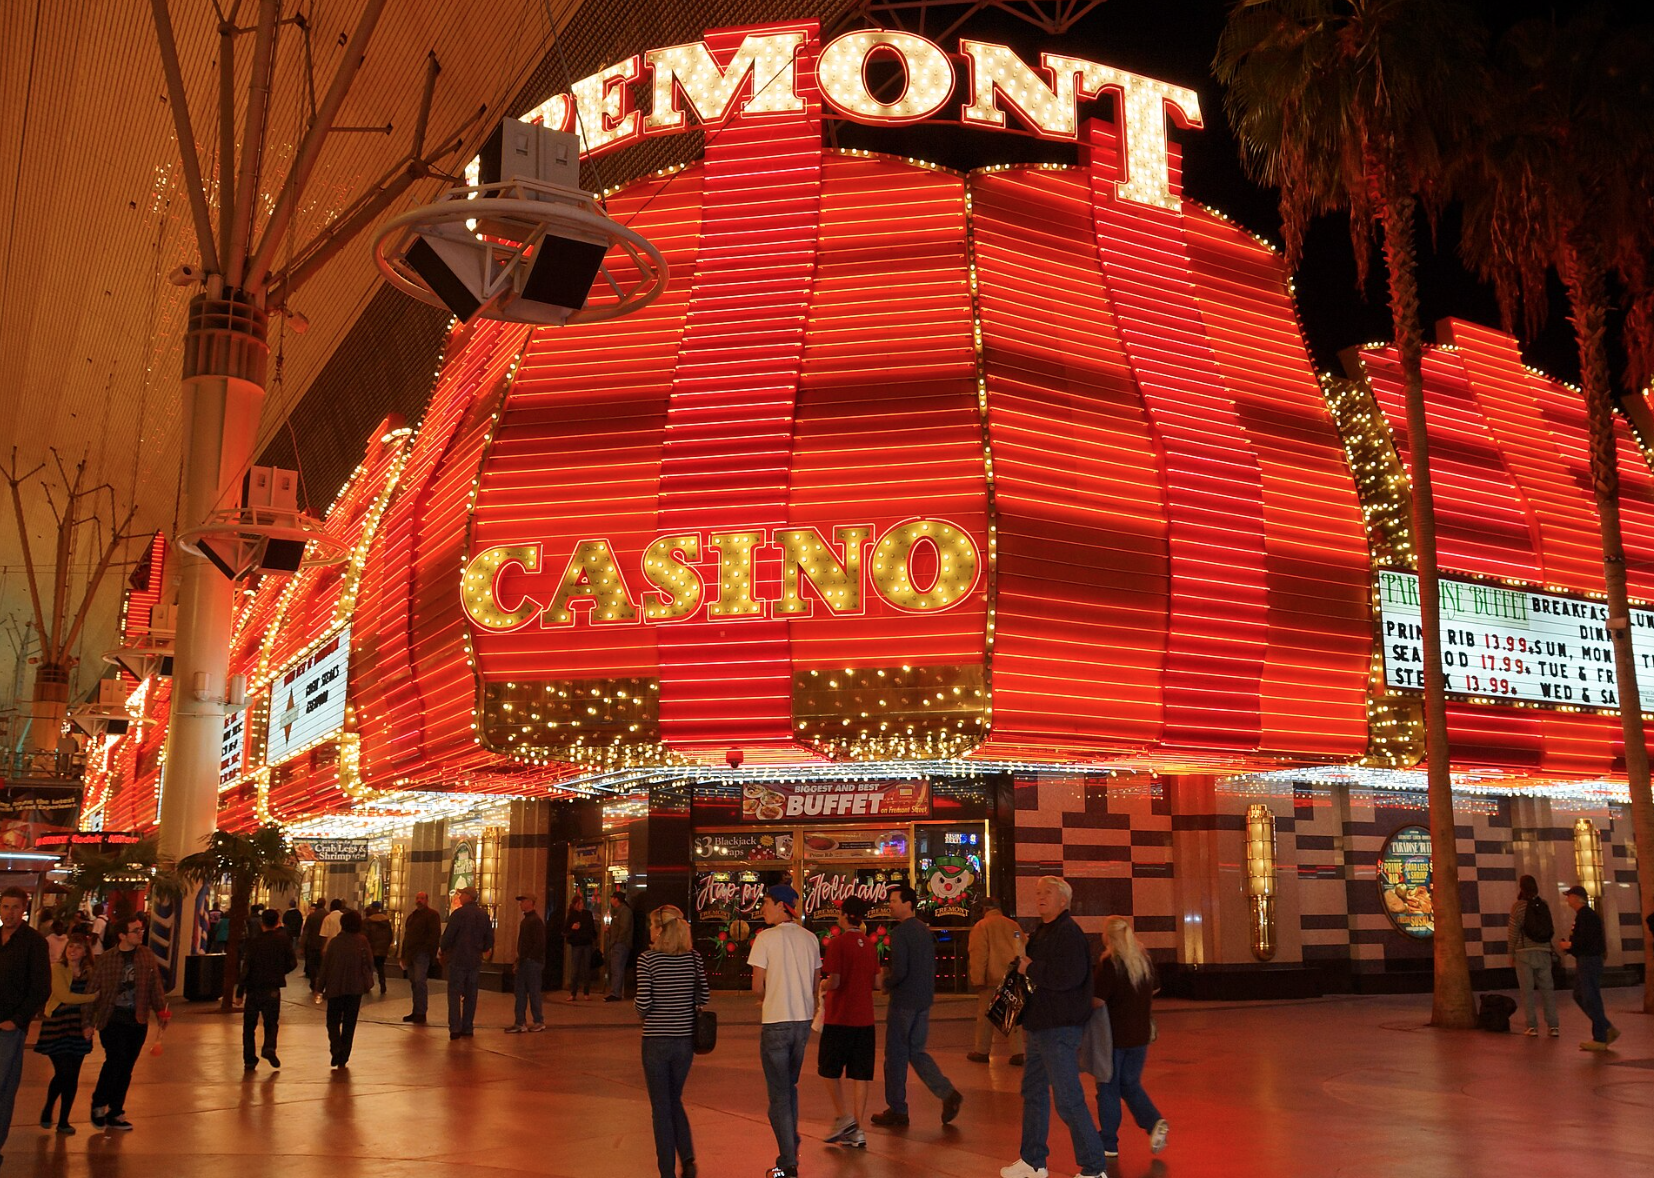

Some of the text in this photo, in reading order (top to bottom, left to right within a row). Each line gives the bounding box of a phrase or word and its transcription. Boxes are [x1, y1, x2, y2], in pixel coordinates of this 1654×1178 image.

[466, 28, 1206, 215] EMONT
[460, 517, 982, 633] CASINO
[1381, 573, 1528, 621] PARISE BUFFET
[1532, 597, 1607, 621] BREAKFAS
[1448, 629, 1475, 647] RIB
[1582, 646, 1612, 663] MON
[1393, 644, 1469, 668] SEAOD
[1538, 661, 1568, 679] TUE
[1579, 666, 1587, 681] &
[1597, 668, 1615, 684] FR
[1395, 667, 1452, 690] STEK
[1540, 682, 1573, 700] WED
[1582, 688, 1590, 703] &
[1601, 689, 1617, 704] SA
[795, 783, 880, 793] BIGGEST AND BEST
[786, 793, 884, 816] BUFFET
[889, 805, 910, 814] Fremont
[912, 805, 927, 814] Street
[315, 844, 366, 854] Crab Legs &
[715, 836, 757, 846] Blackjack
[320, 851, 351, 862] Shrimp
[697, 872, 900, 914] Happy Holidays
[867, 907, 891, 918] FREMO
[935, 906, 969, 917] FREMONT
